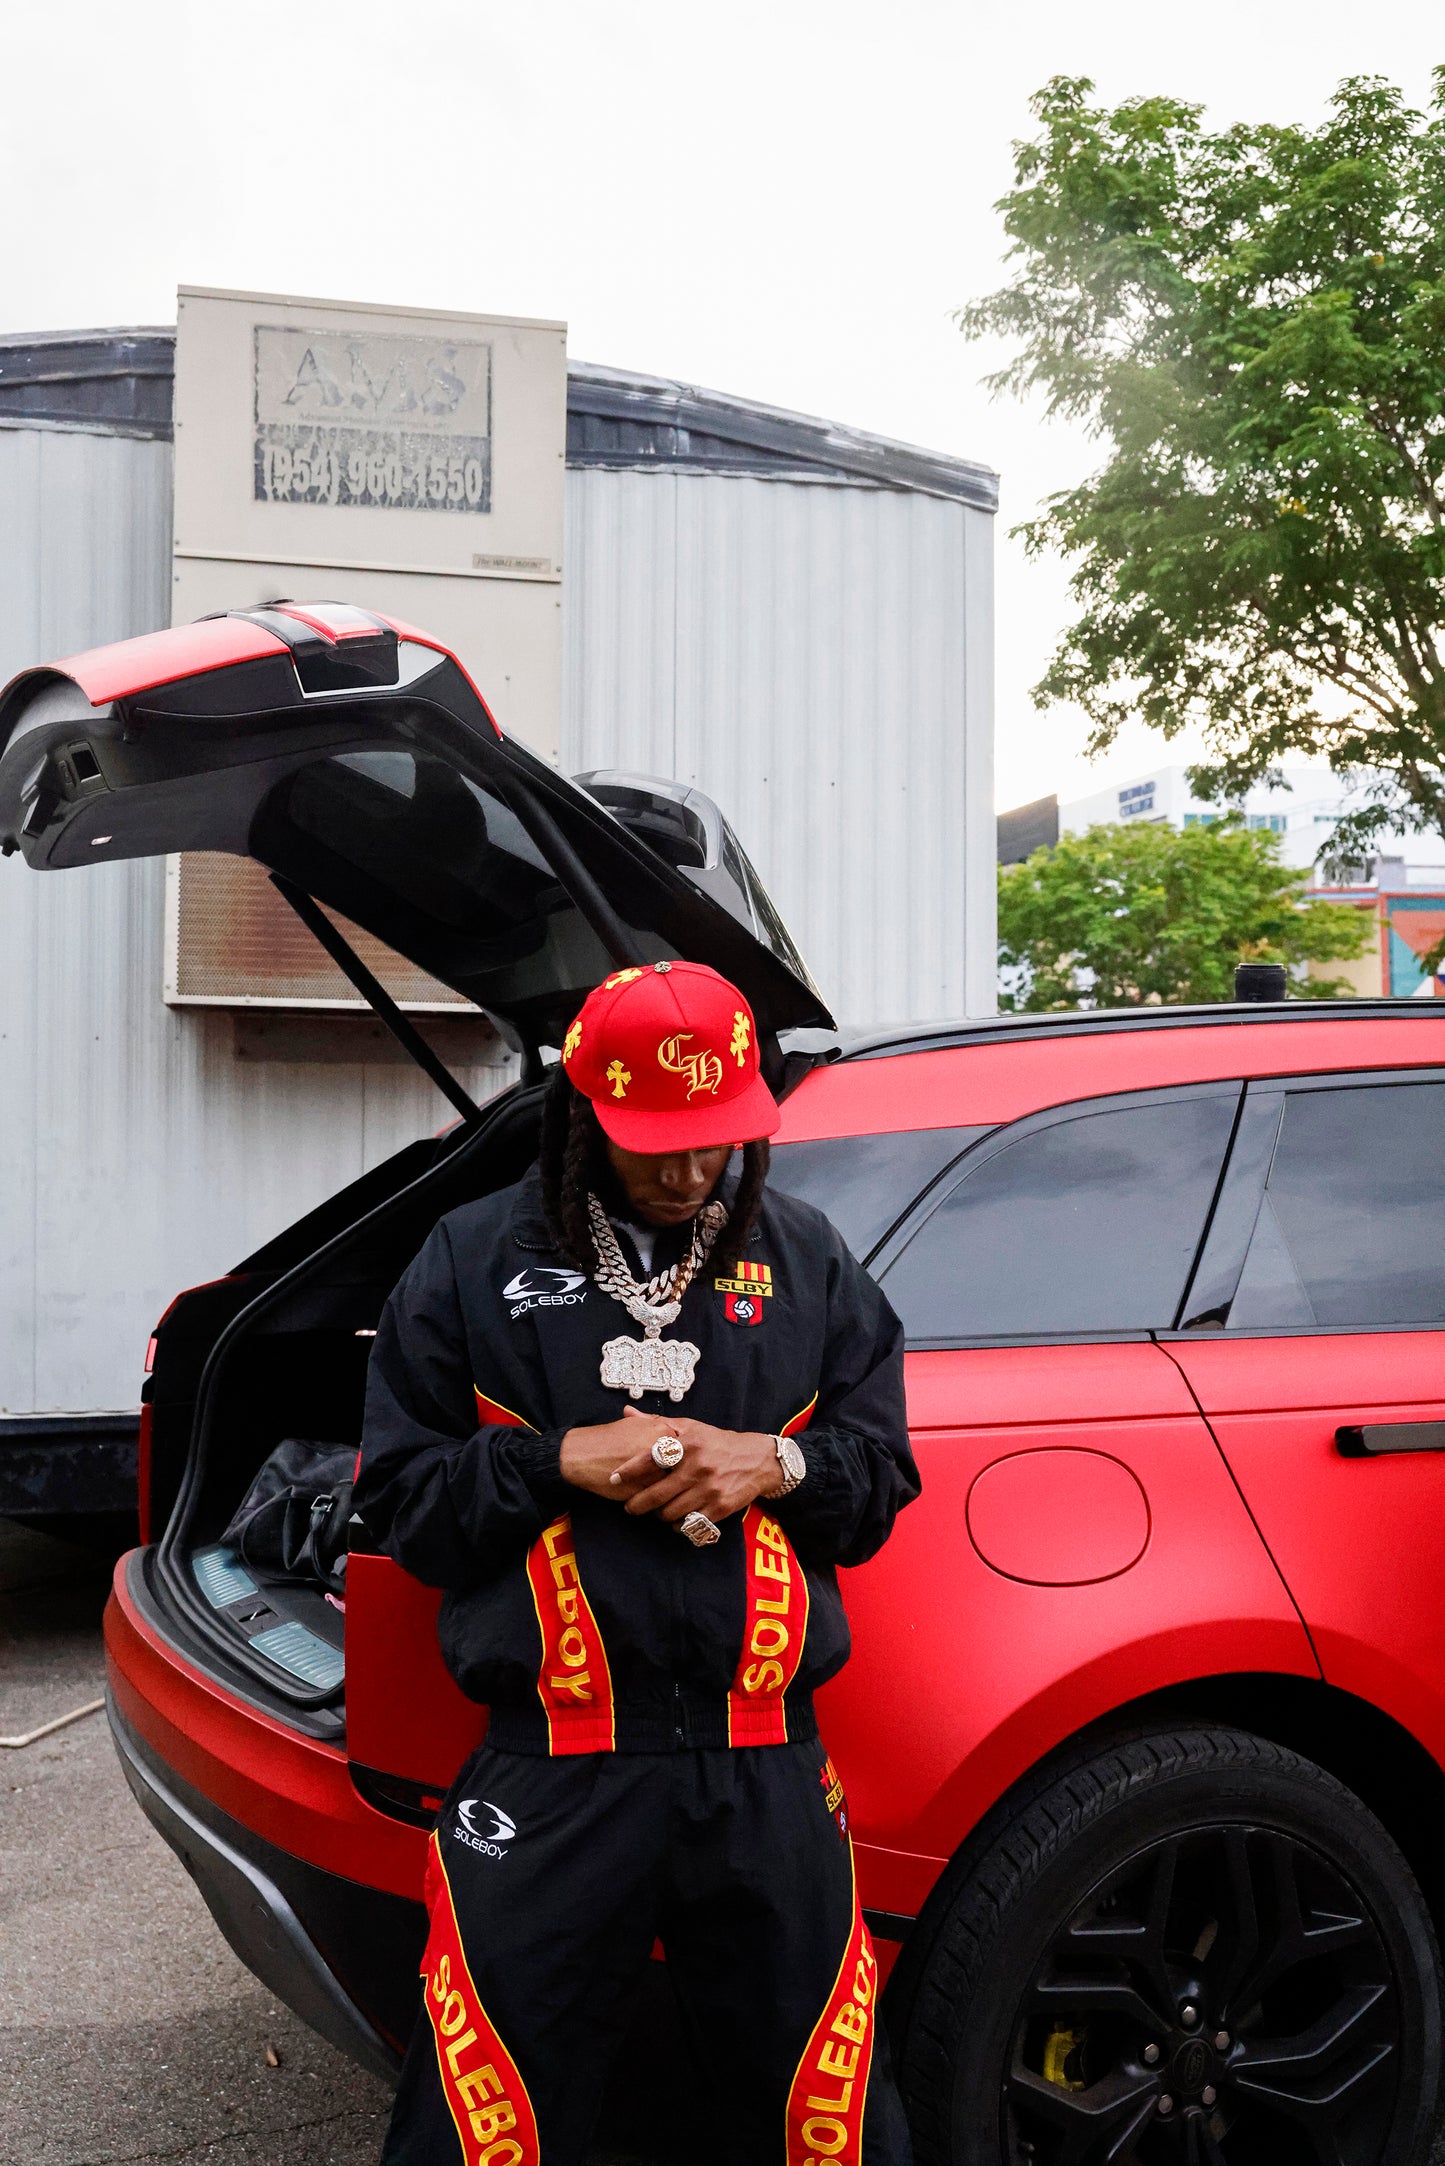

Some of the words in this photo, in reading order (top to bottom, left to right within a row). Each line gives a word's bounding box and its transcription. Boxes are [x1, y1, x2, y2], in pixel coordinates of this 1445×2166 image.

[348, 449, 483, 503] 960-1550
[717, 1280, 769, 1294] SLBY
[510, 1292, 587, 1319] SOLEBOY
[742, 1516, 791, 1693] SOLEB
[453, 1827, 508, 1860] SOLEBOY
